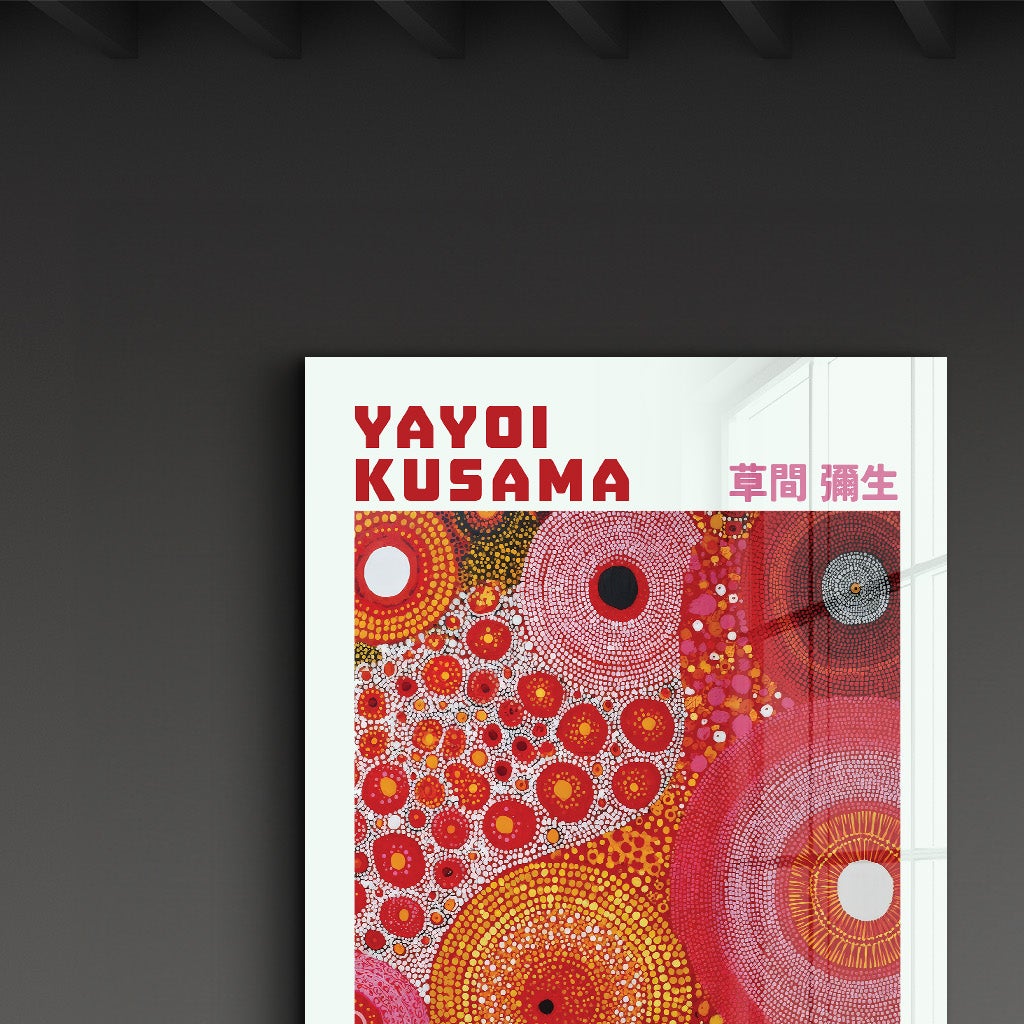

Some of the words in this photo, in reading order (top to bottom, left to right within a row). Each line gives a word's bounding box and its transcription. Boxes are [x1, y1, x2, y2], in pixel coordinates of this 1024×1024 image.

[355, 406, 547, 449] YAYOI
[356, 459, 629, 501] KUSAMA
[729, 463, 806, 502] 草間
[821, 463, 898, 502] 彌生
